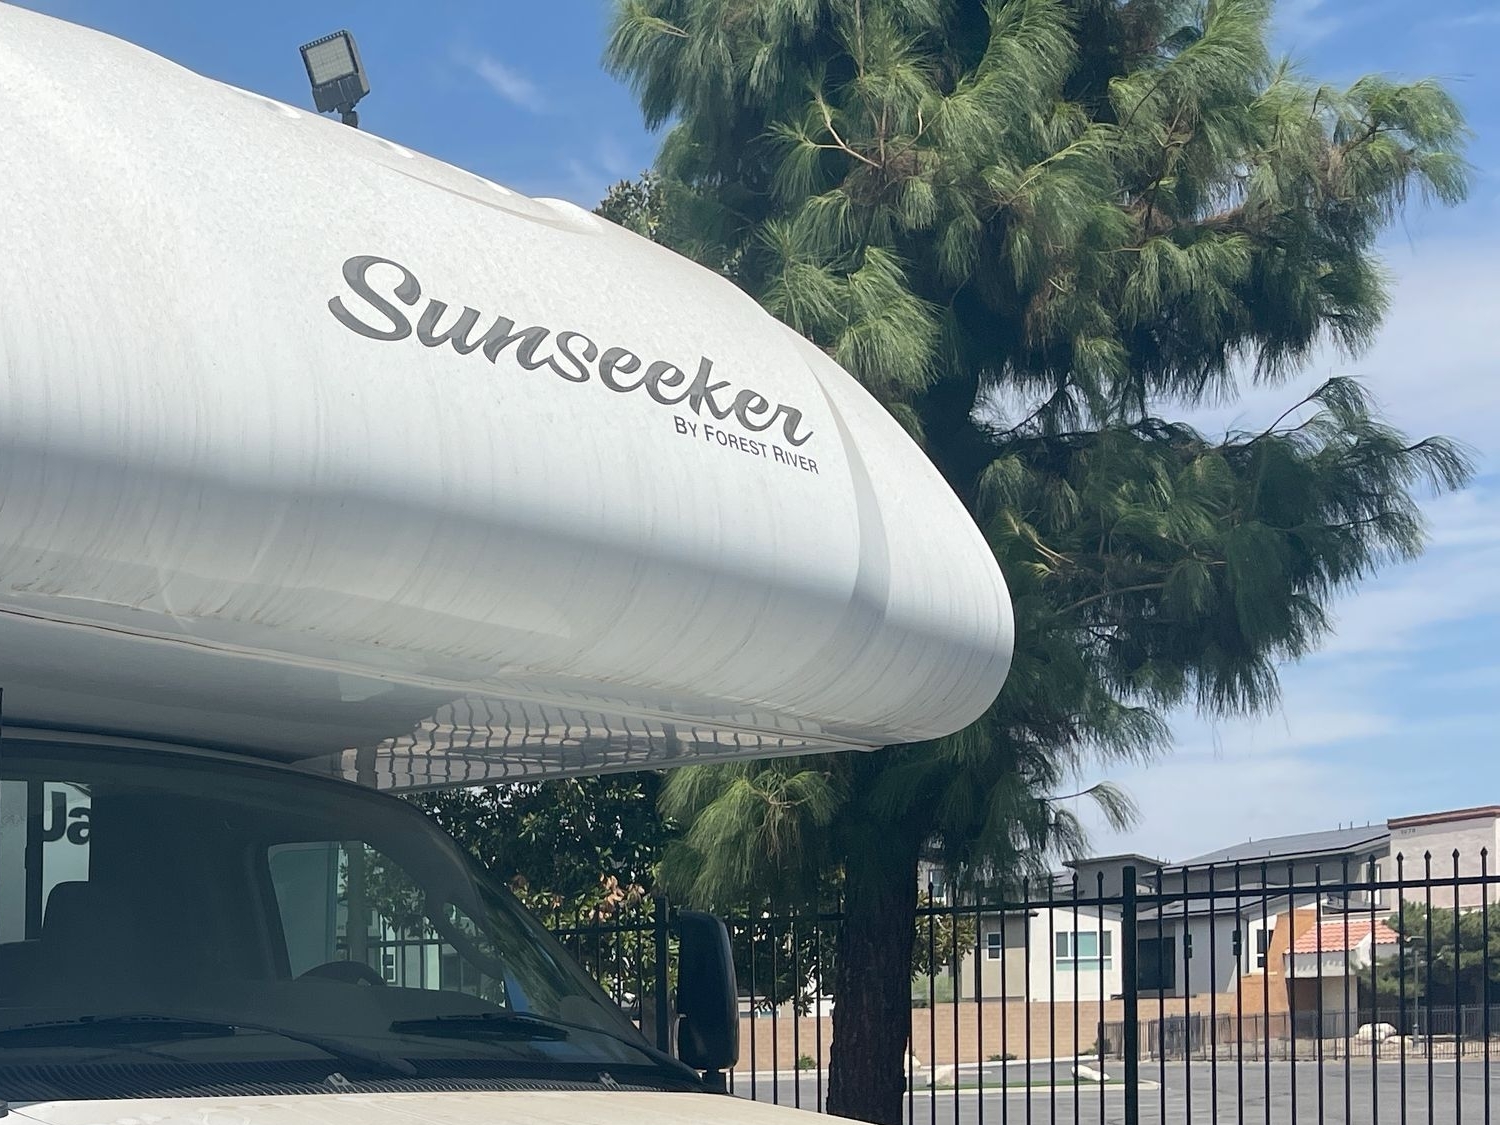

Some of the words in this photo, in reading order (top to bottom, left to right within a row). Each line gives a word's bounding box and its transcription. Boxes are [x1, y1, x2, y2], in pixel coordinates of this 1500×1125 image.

[328, 255, 813, 447] Sunseeker
[704, 425, 768, 458] FOREST
[772, 445, 820, 475] RIVER
